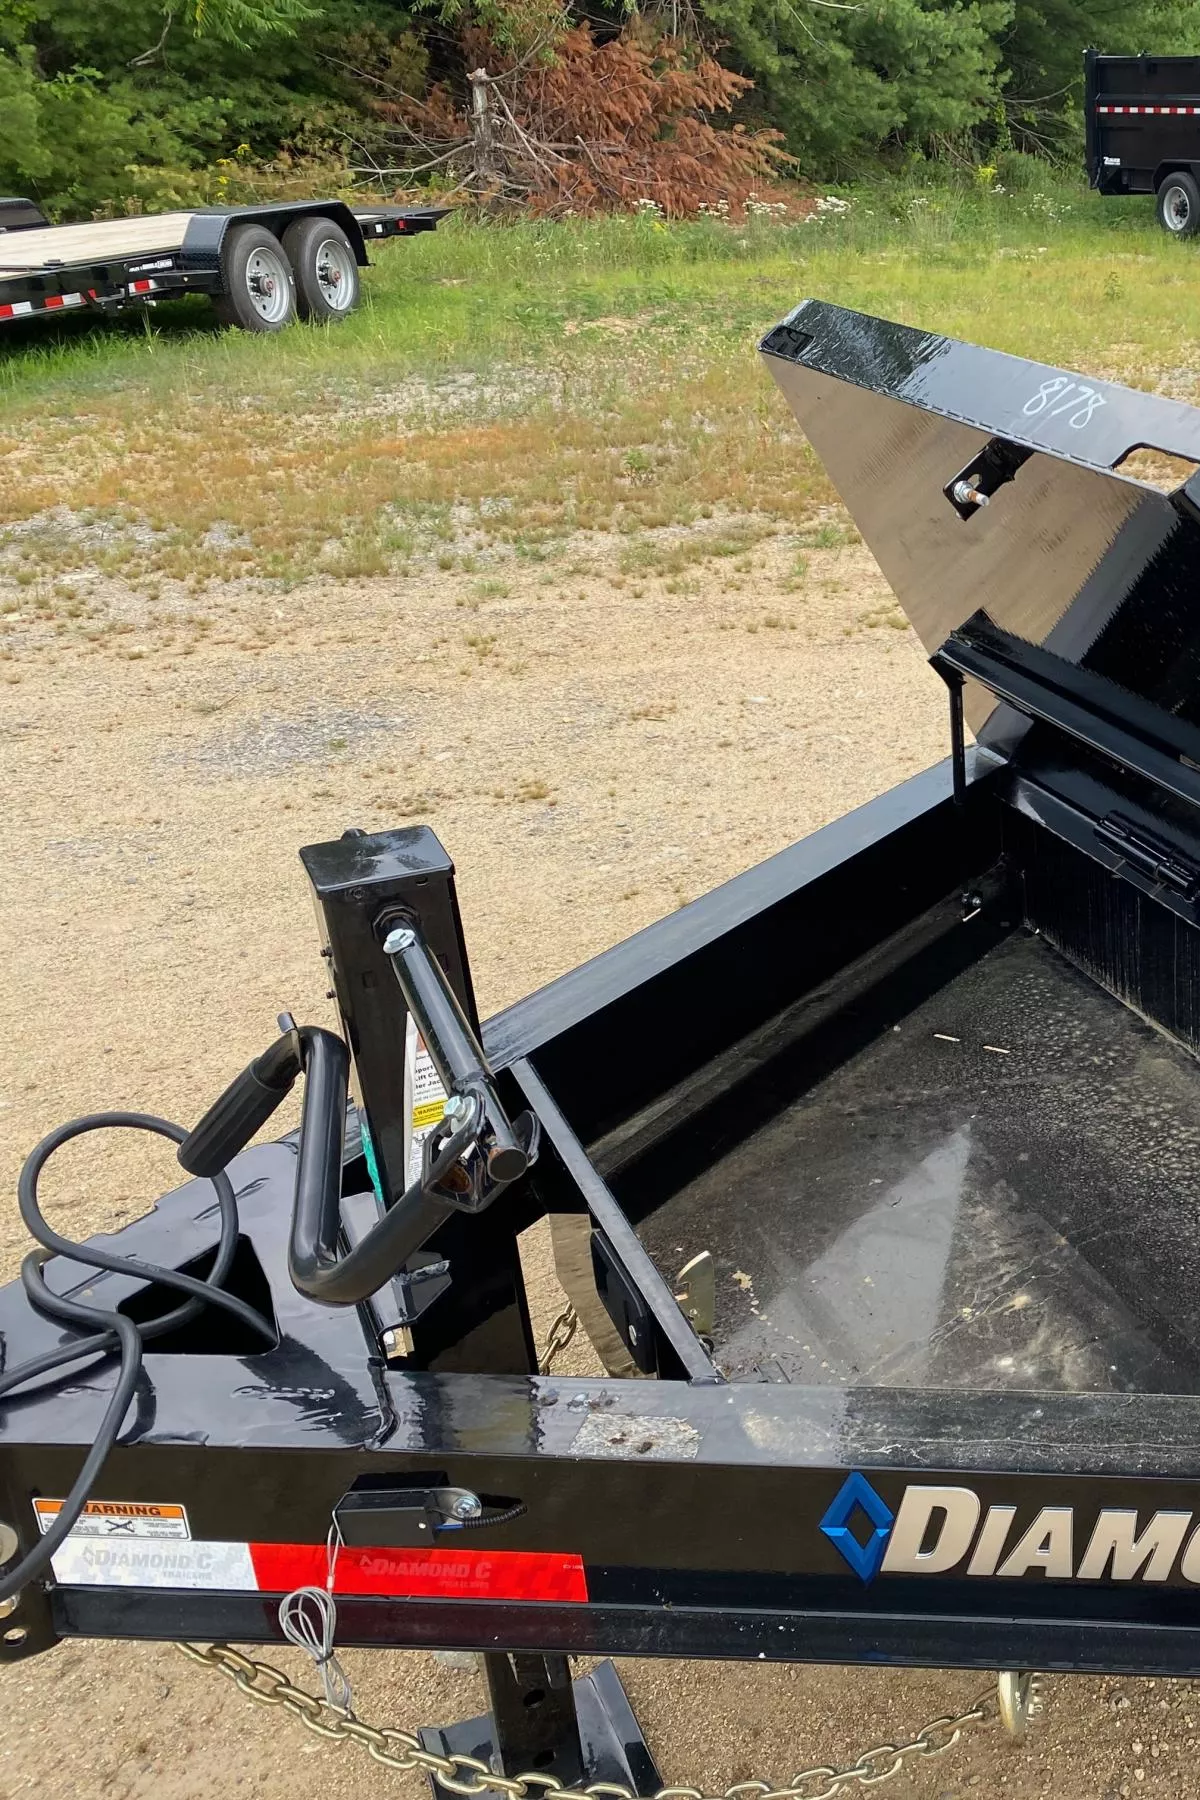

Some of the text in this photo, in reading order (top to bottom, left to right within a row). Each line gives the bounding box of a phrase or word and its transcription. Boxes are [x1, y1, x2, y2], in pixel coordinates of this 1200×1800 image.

[1022, 376, 1108, 429] 8178
[94, 1549, 213, 1570] DIAMOND C
[369, 1558, 492, 1579] DIAMOND C
